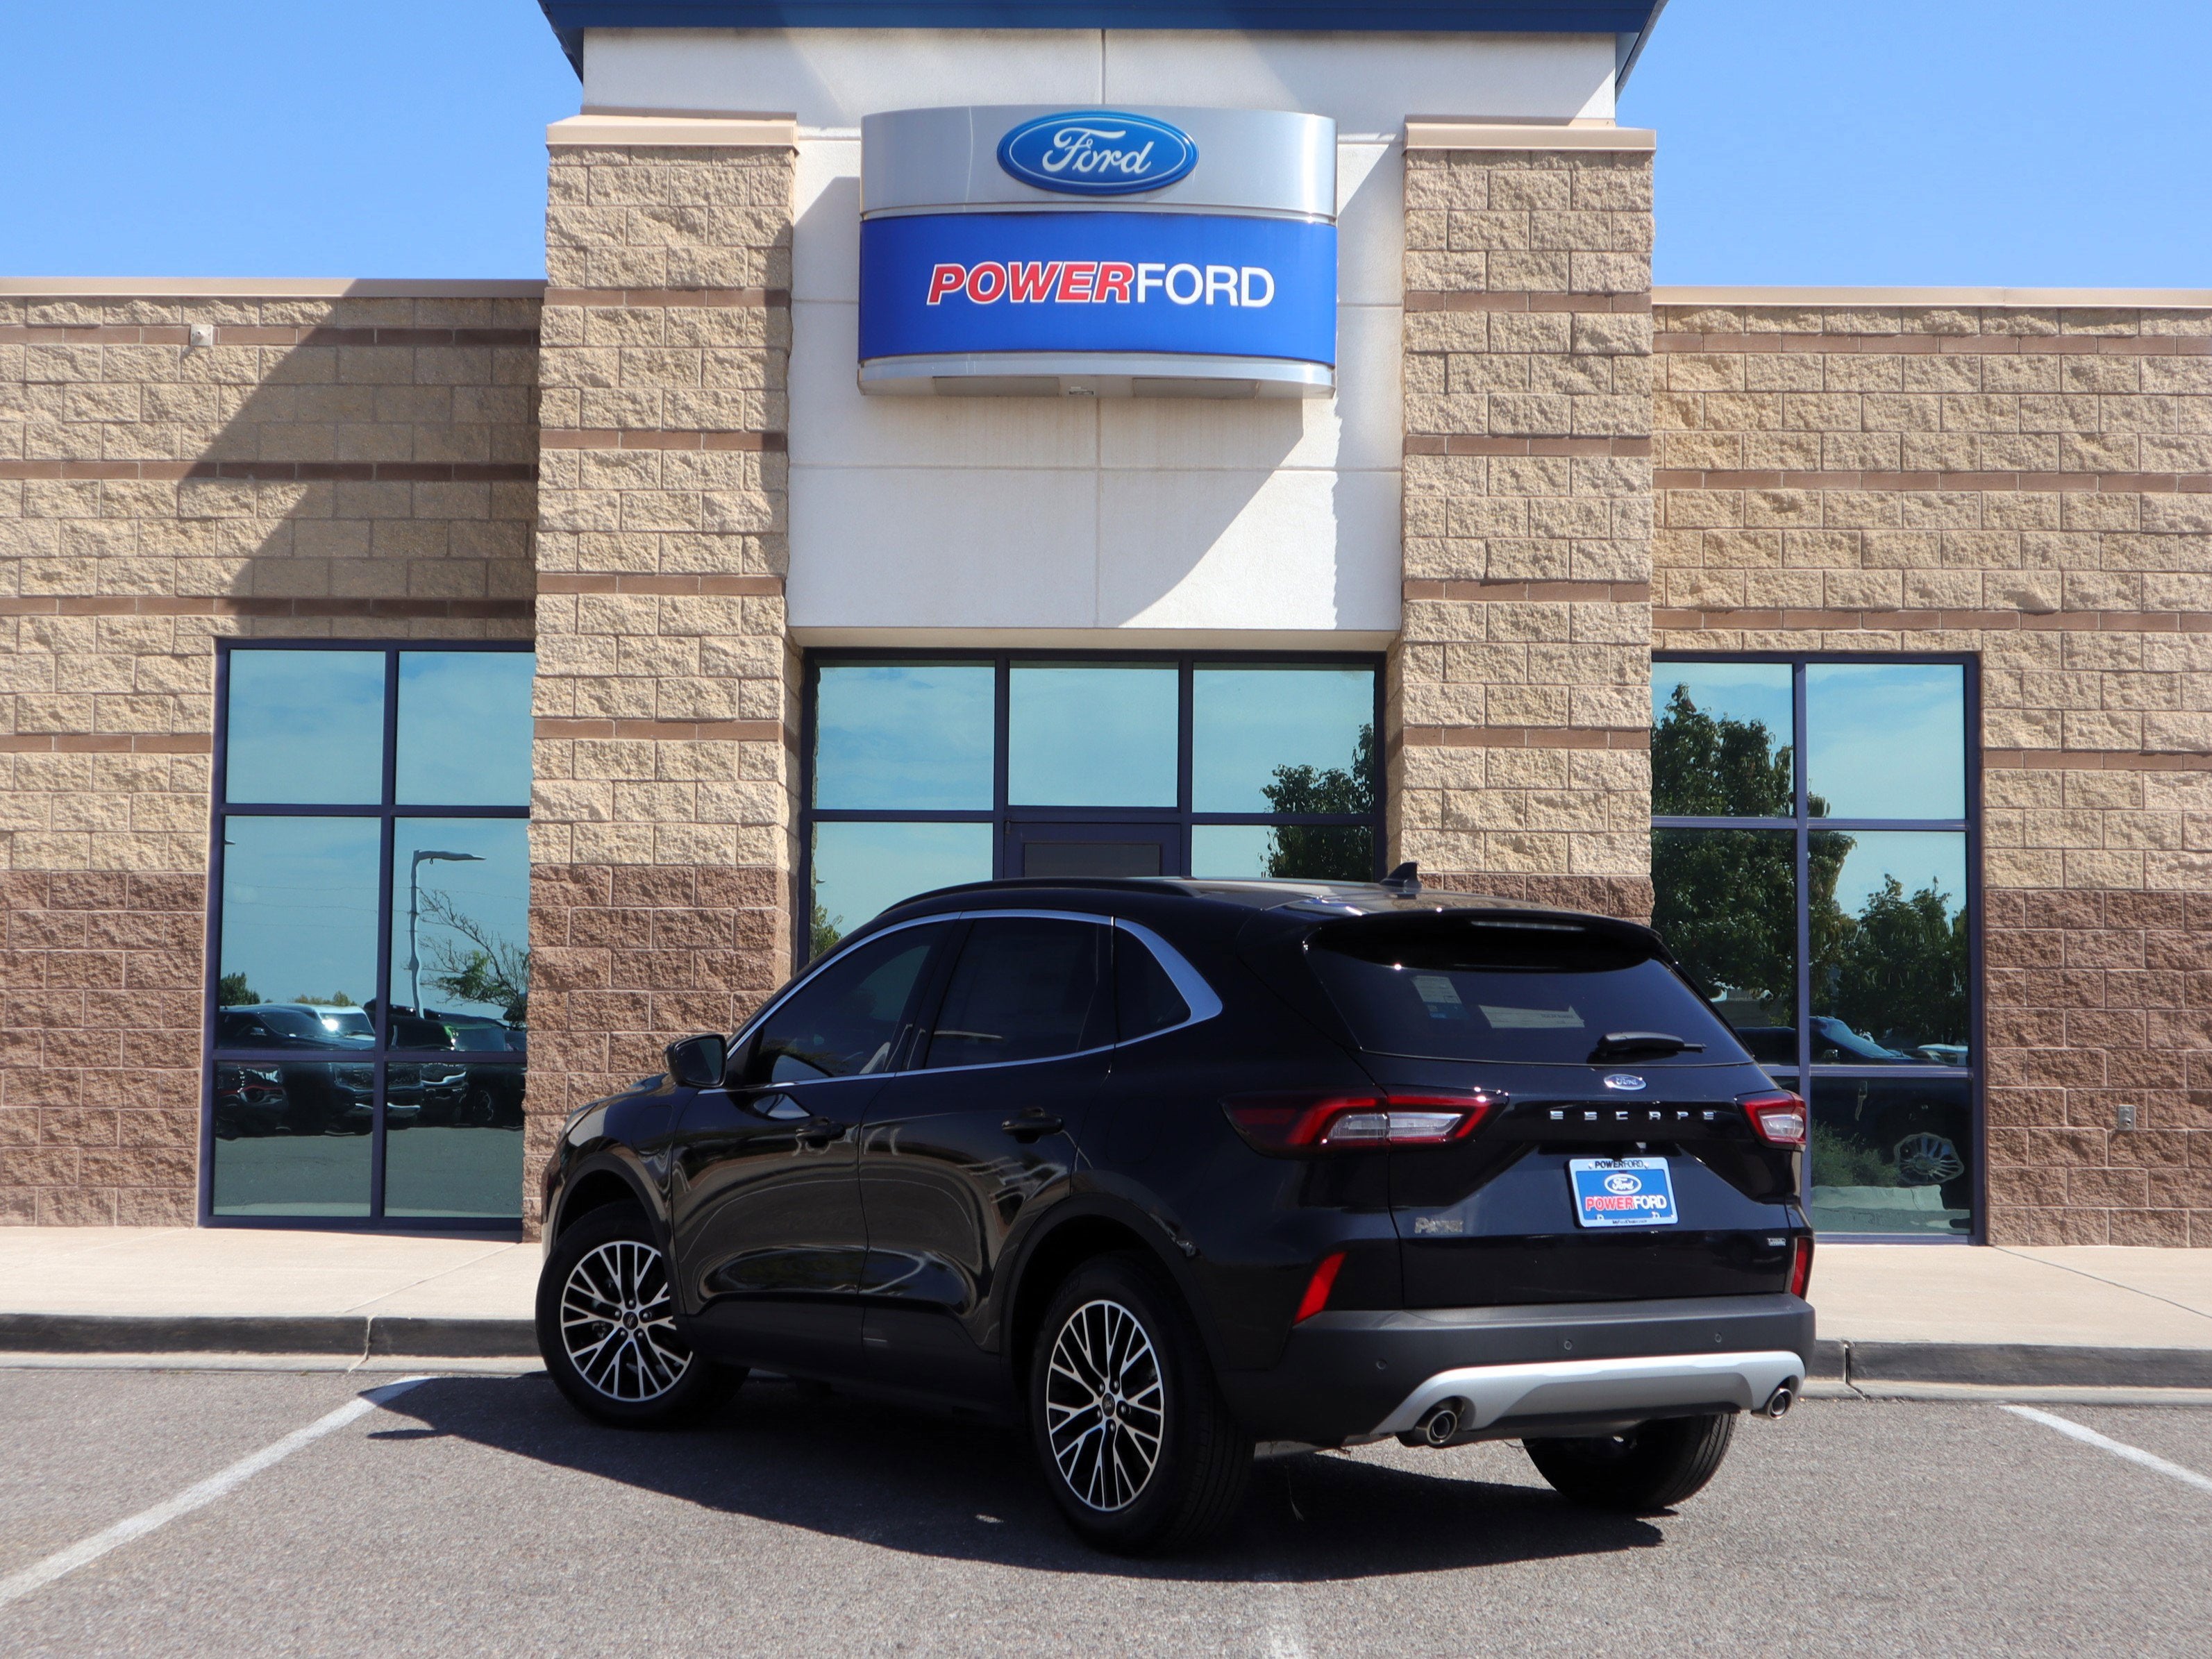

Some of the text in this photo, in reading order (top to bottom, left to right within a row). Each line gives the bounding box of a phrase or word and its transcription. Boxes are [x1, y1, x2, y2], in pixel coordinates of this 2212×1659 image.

[1042, 127, 1155, 174] Ford
[926, 261, 1275, 308] POWERFORD
[1550, 1111, 1714, 1120] ESCAPE
[1611, 1178, 1634, 1190] Ford
[1586, 1195, 1667, 1211] POWERFORD
